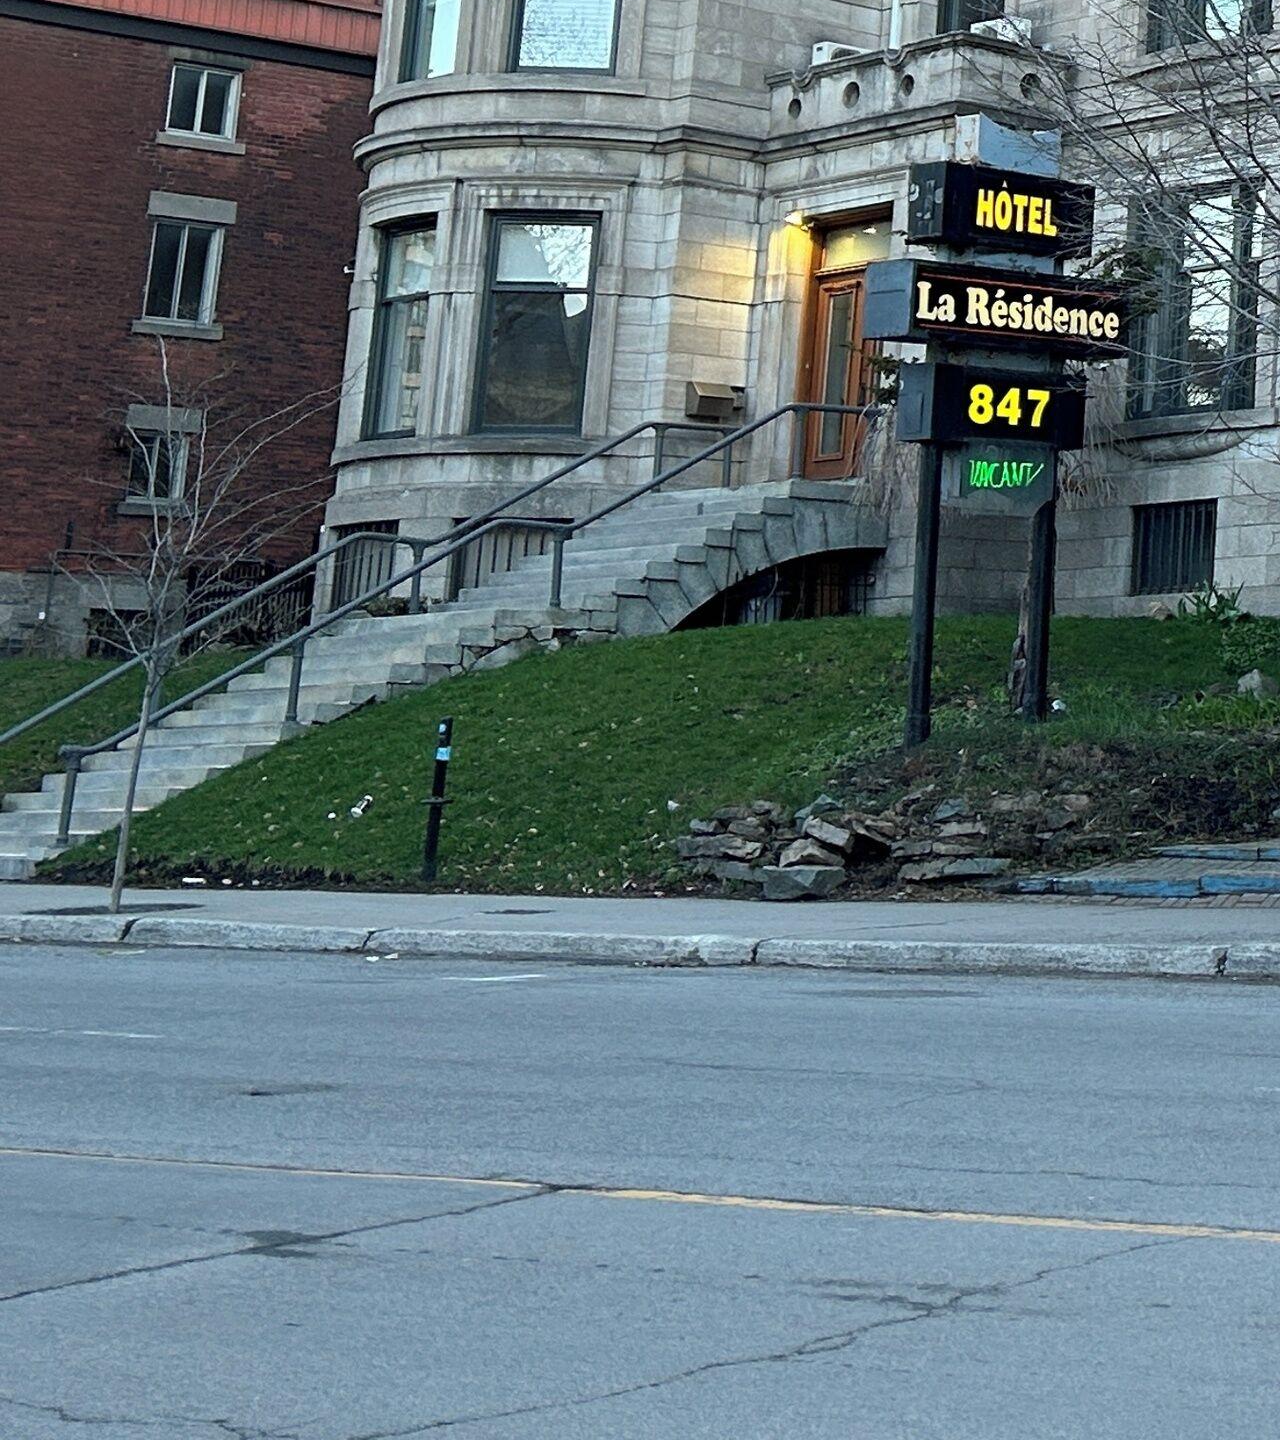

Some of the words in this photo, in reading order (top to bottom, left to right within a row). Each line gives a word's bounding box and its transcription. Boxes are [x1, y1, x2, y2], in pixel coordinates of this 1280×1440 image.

[976, 180, 1057, 237] HÔTEL
[916, 281, 956, 322] La
[966, 287, 1119, 338] Résidence
[968, 384, 1050, 427] 847
